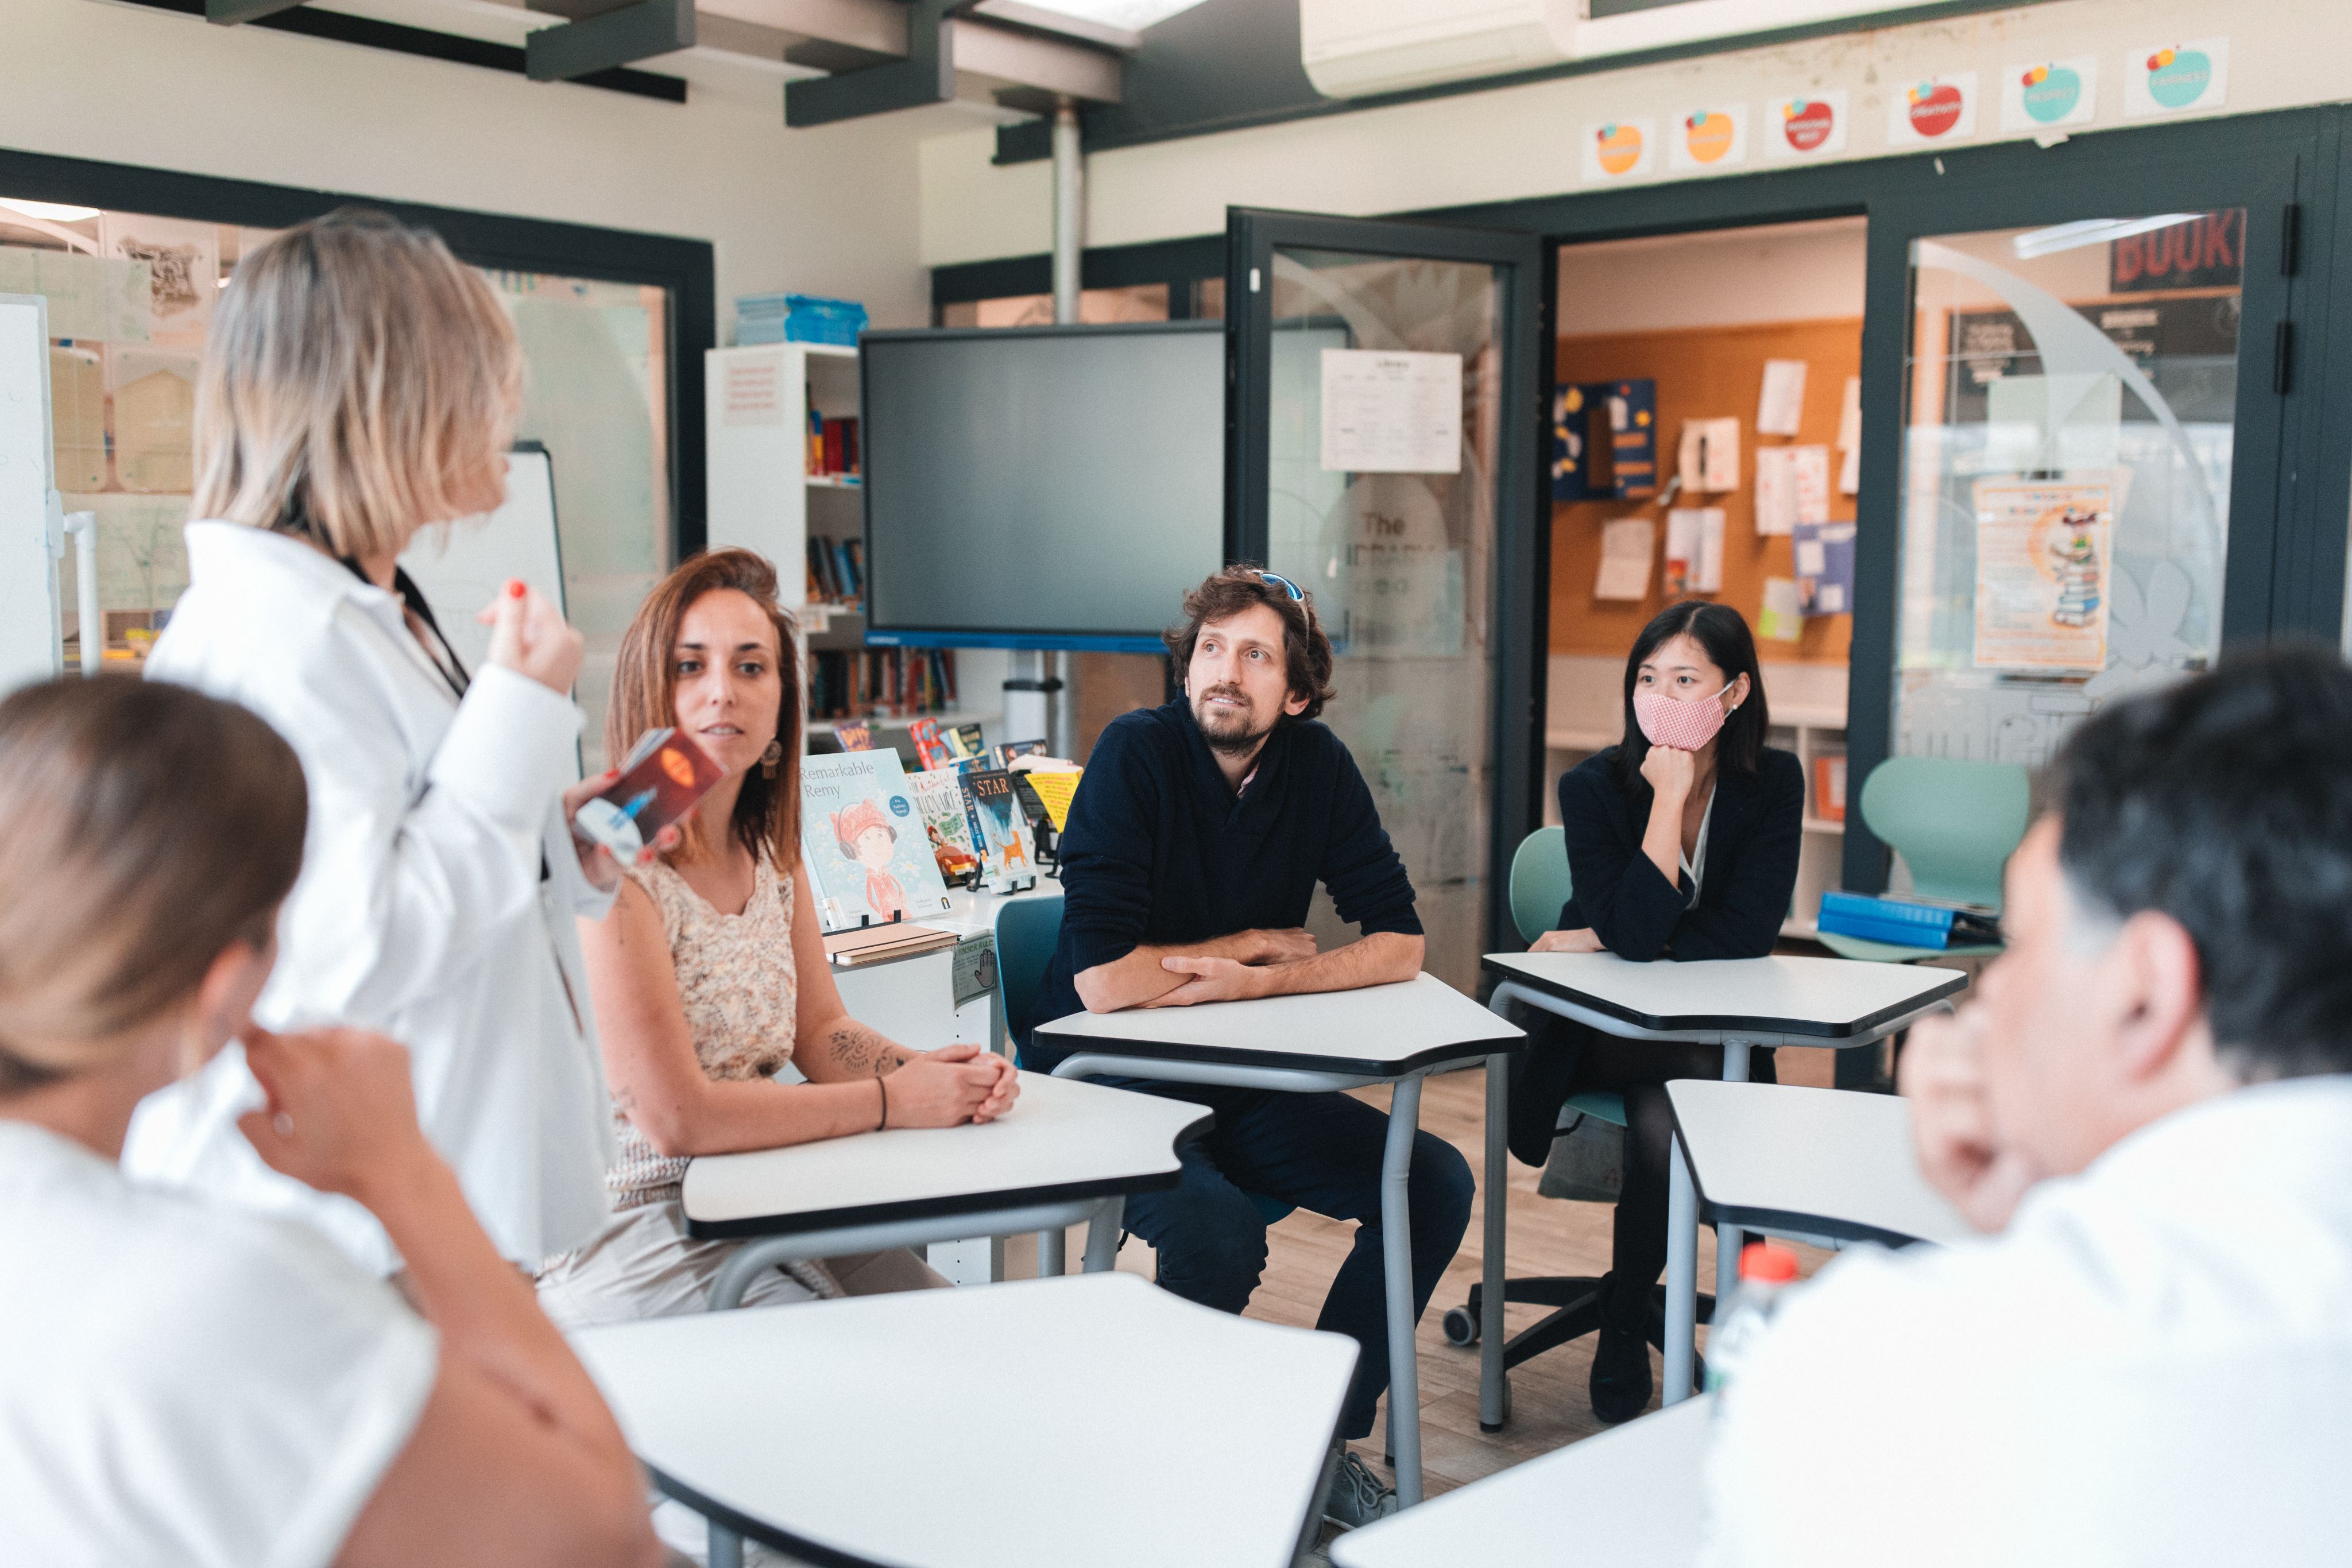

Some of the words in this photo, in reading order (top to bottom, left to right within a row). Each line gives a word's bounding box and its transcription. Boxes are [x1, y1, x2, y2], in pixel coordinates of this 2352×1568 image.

[2116, 207, 2246, 283] BOOK
[1360, 512, 1406, 535] The
[800, 761, 875, 781] Remarkable
[804, 784, 840, 799] Remy
[977, 778, 1009, 796] STAR
[913, 789, 958, 814] ILLIONAIRE
[961, 787, 974, 811] STAR
[978, 939, 994, 950] RULE
